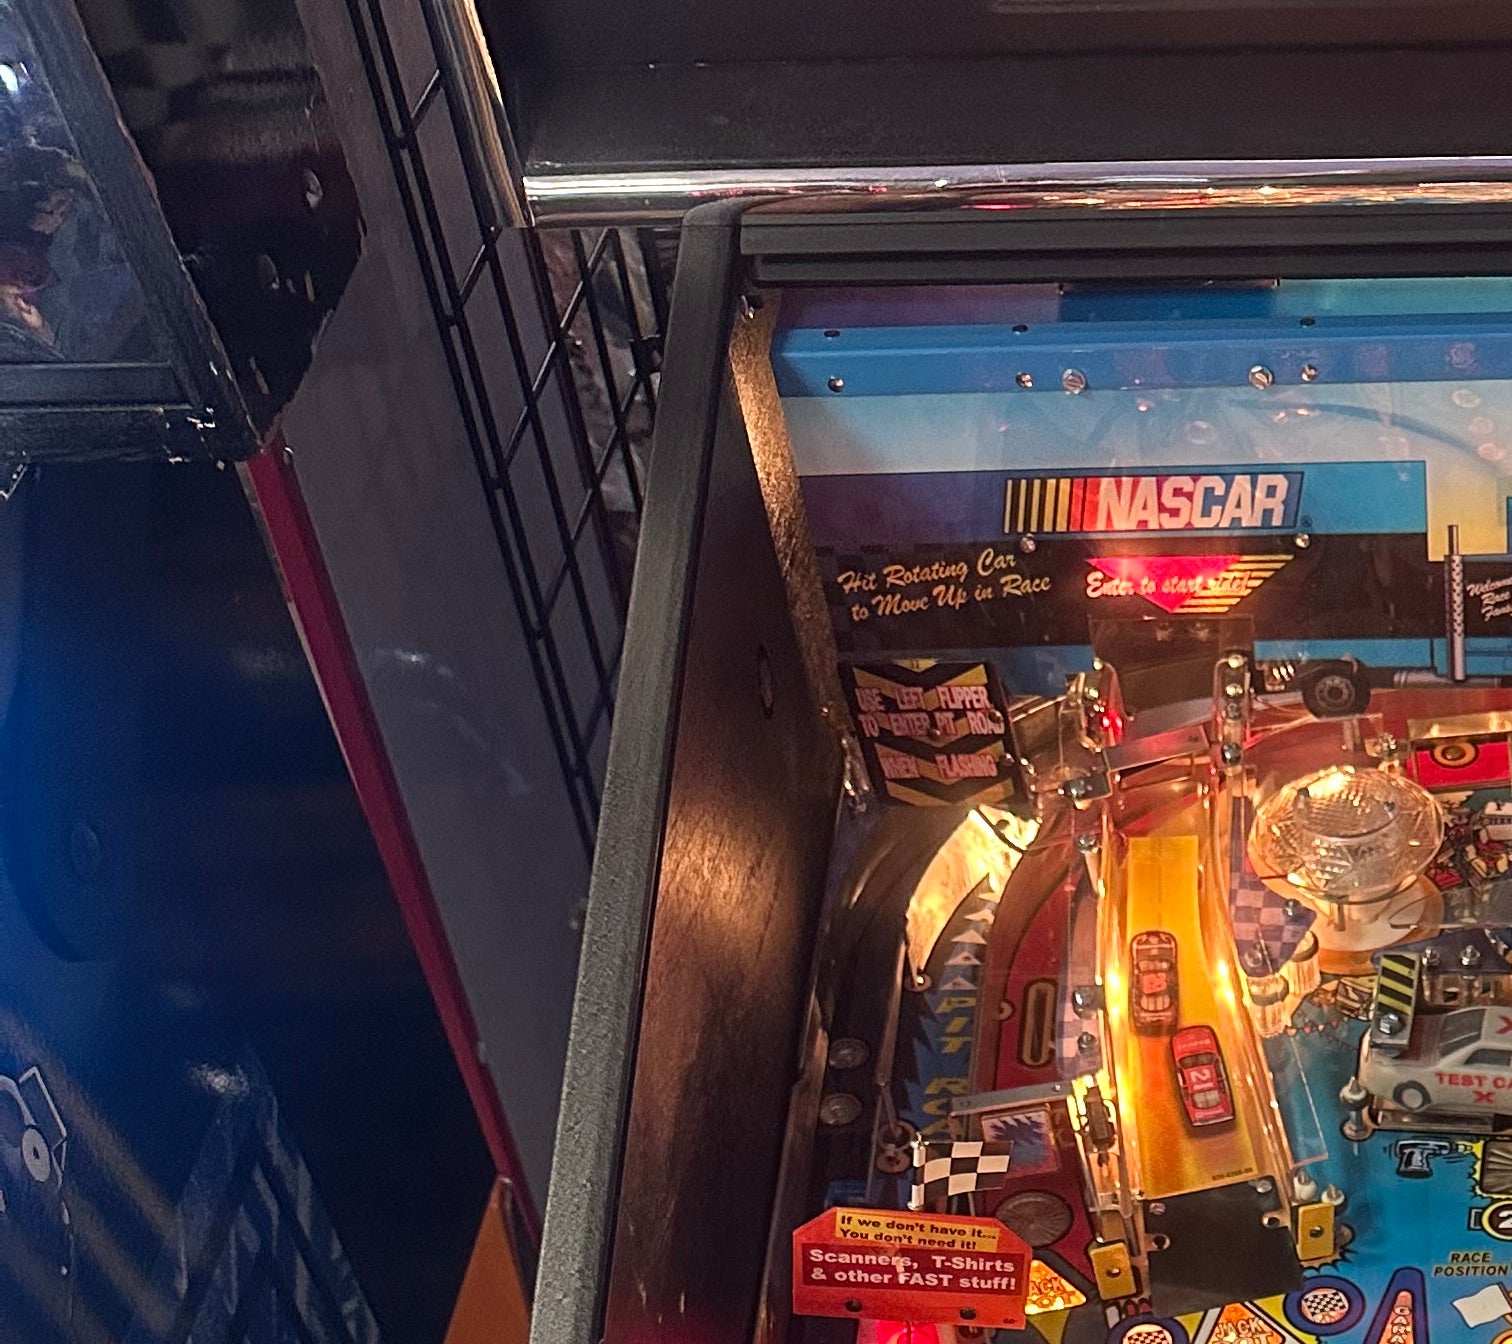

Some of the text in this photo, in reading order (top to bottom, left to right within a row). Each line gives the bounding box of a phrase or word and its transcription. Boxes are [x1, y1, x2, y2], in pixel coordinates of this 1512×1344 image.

[1097, 474, 1289, 531] NASCAR
[837, 548, 1016, 594] Hit Rotating Car
[851, 574, 1052, 622] to Move Up in Race
[1086, 572, 1135, 599] Enter
[1434, 1071, 1487, 1090] TEST
[839, 1227, 978, 1250] You don't need it!
[840, 1214, 855, 1230] If
[858, 1219, 876, 1232] we
[878, 1215, 925, 1235] don't
[929, 1221, 966, 1238] have
[809, 1248, 1016, 1274] Scanners, T-Shirts
[1449, 1250, 1492, 1266] RACE
[811, 1266, 1018, 1291] & other FAST stuff!
[1433, 1263, 1510, 1279] POSITION
